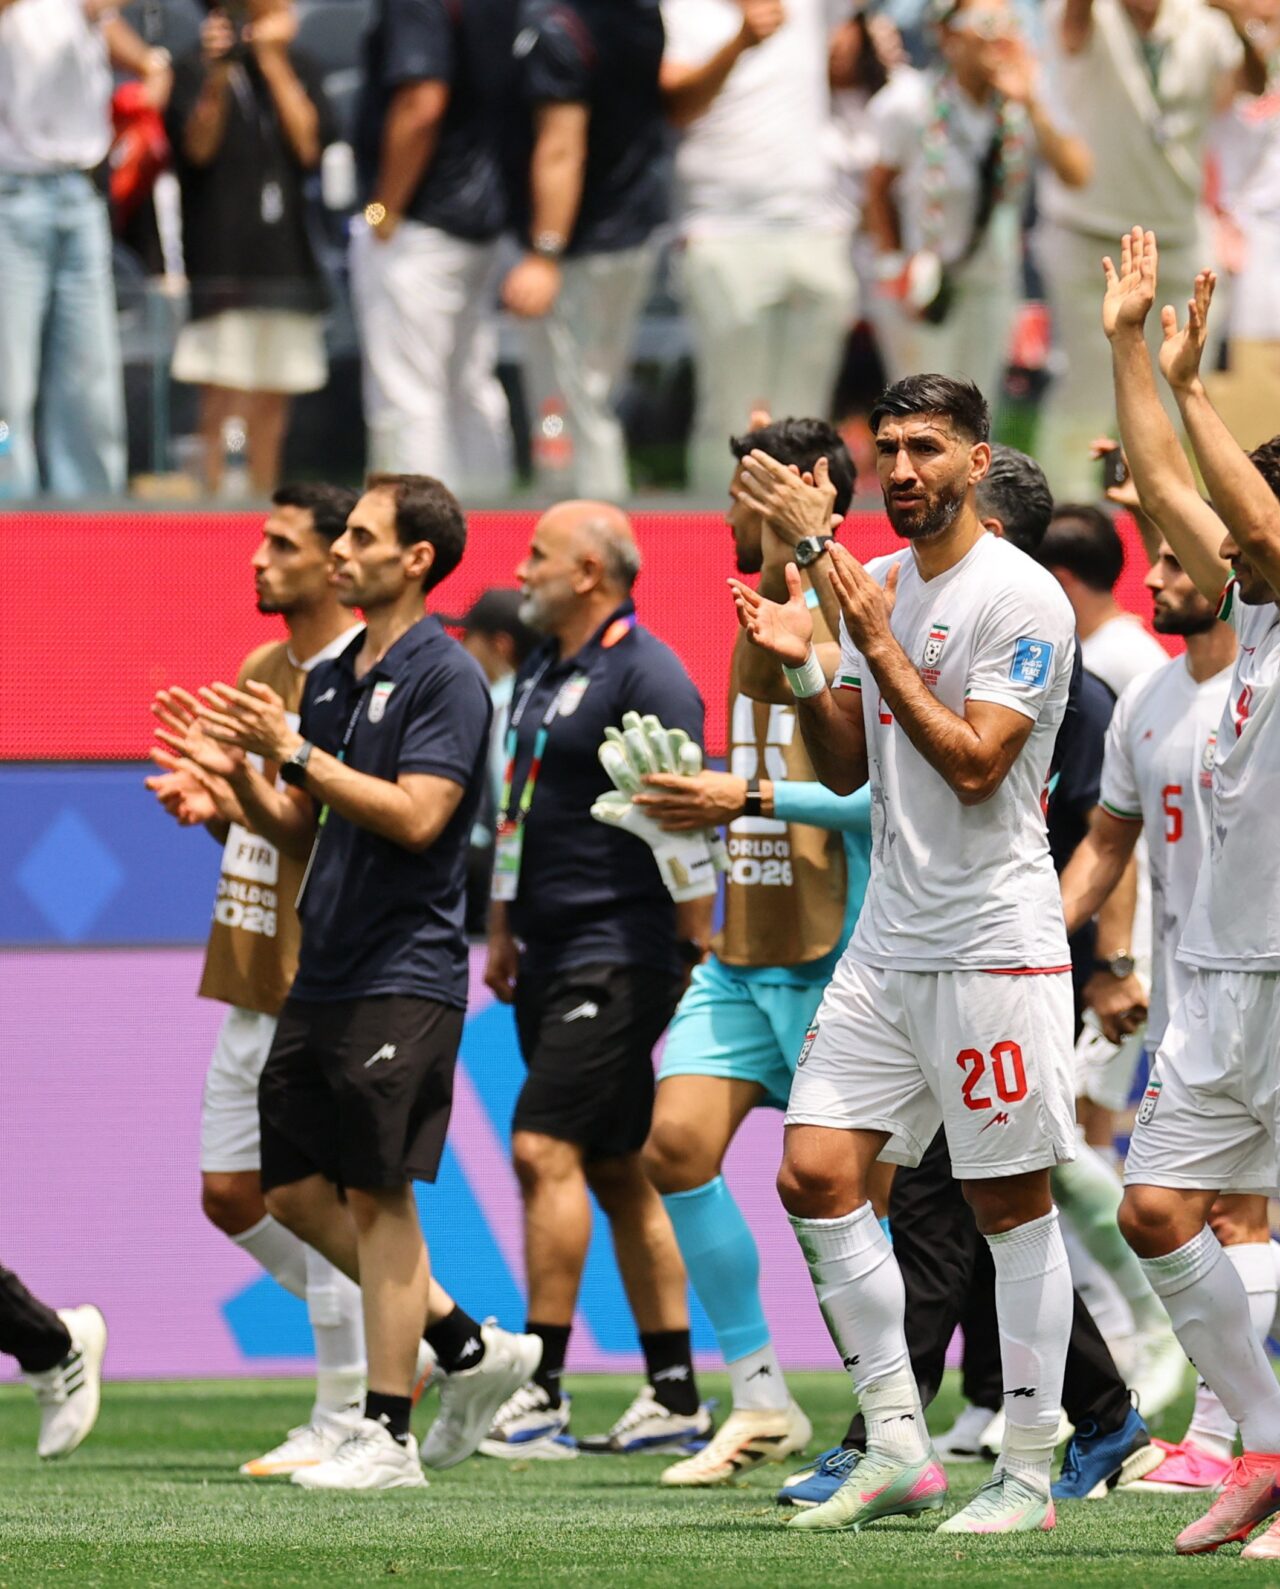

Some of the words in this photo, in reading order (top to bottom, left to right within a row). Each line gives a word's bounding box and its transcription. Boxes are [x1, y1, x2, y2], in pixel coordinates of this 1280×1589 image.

[1162, 784, 1183, 844] 5
[236, 844, 273, 867] FIFA
[729, 839, 773, 857] ORLD
[727, 858, 794, 887] 026
[217, 877, 260, 905] ORLD
[214, 899, 279, 937] 026
[957, 1040, 1028, 1111] 20
